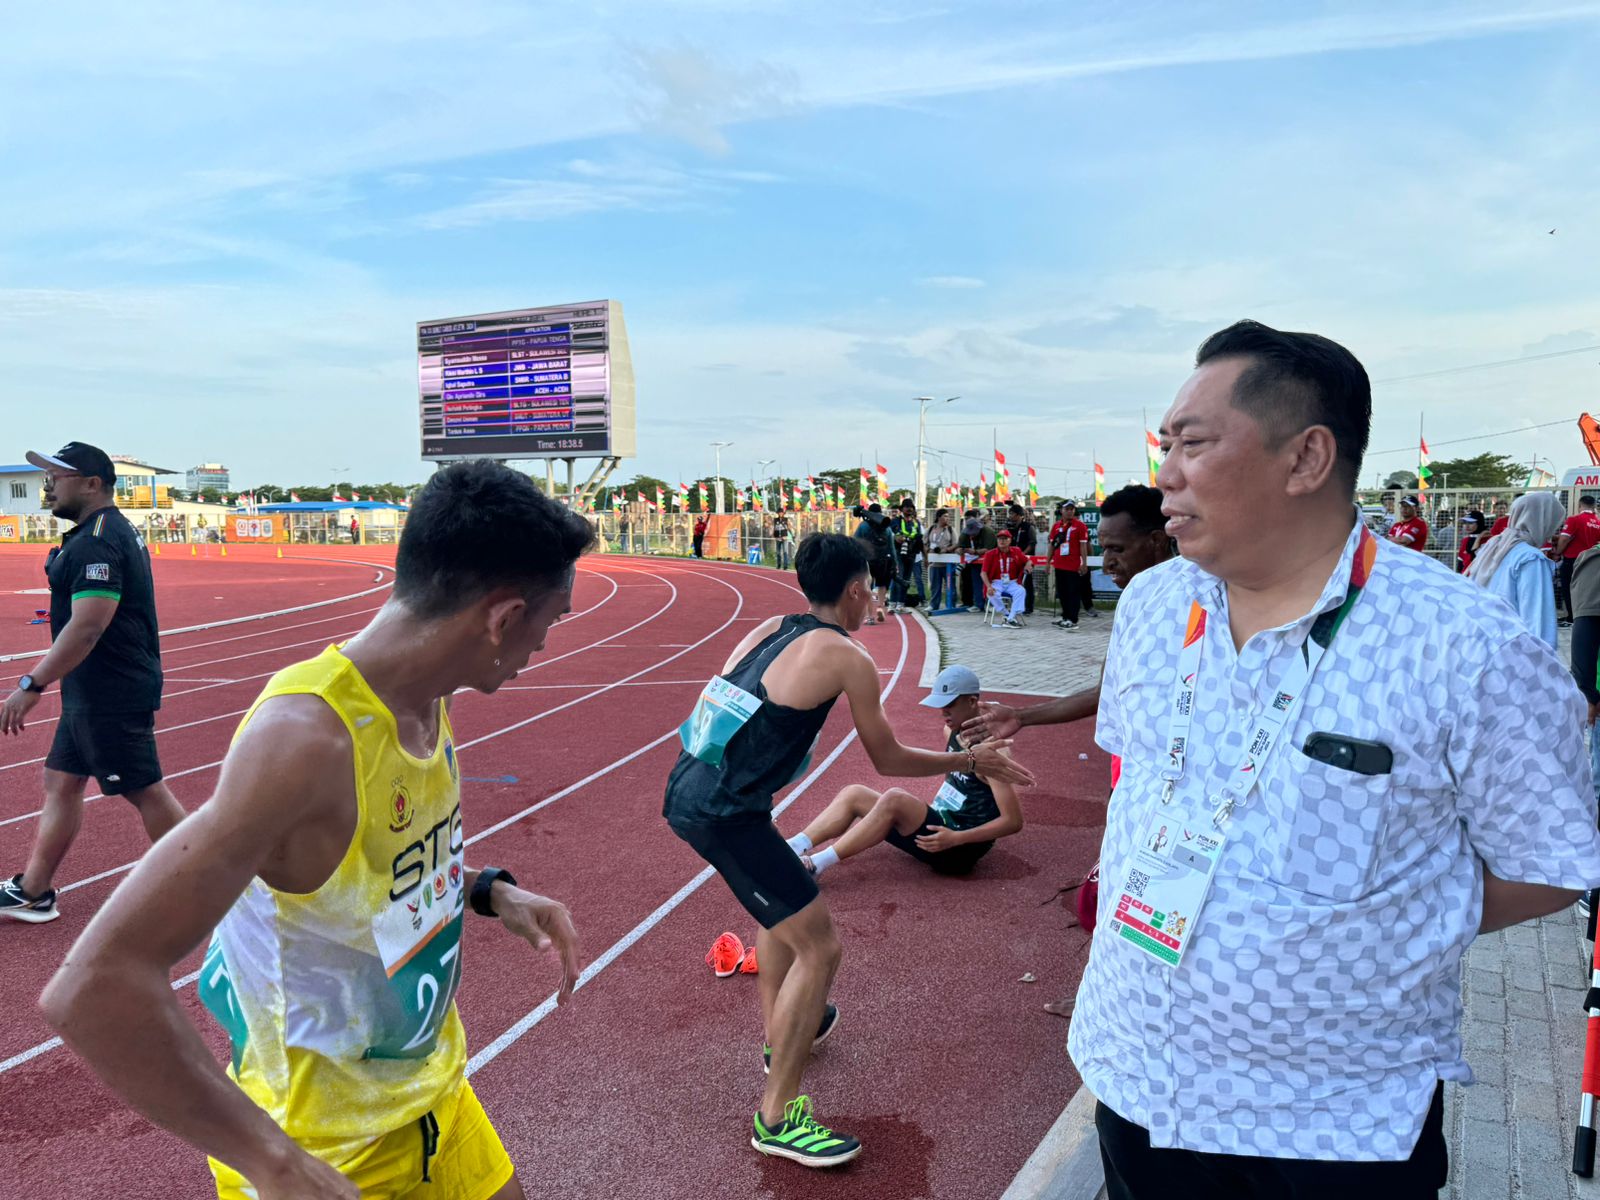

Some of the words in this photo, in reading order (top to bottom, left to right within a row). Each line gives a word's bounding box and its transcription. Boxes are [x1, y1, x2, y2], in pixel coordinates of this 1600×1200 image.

[537, 440, 556, 448] Time:
[558, 439, 583, 448] 18:38.5
[752, 551, 758, 563] 7
